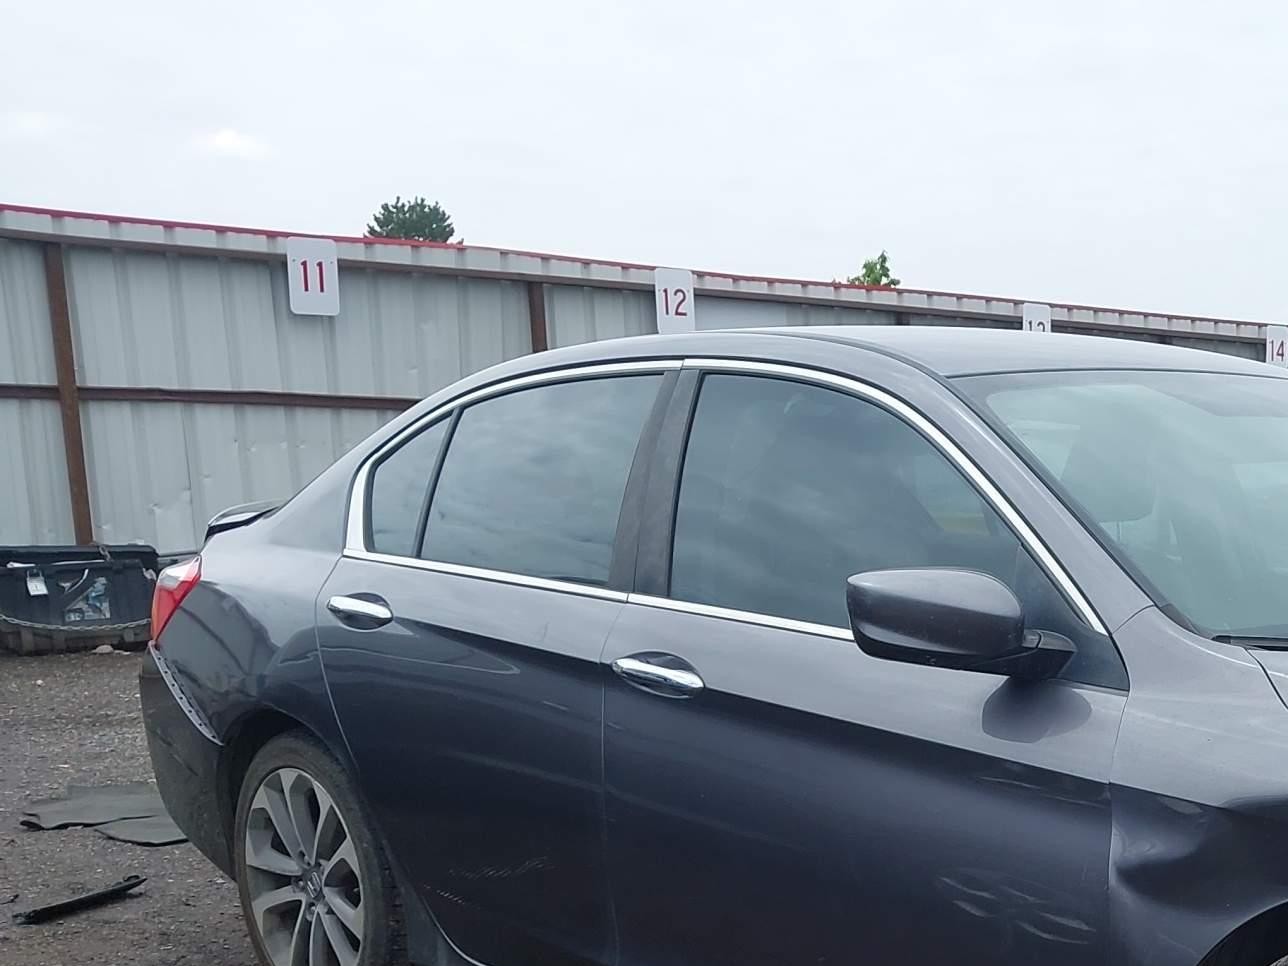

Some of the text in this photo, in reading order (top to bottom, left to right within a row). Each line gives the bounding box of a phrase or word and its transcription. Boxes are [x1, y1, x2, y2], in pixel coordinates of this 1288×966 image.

[300, 260, 325, 293] 11
[662, 288, 688, 317] 12
[1270, 339, 1285, 362] 14
